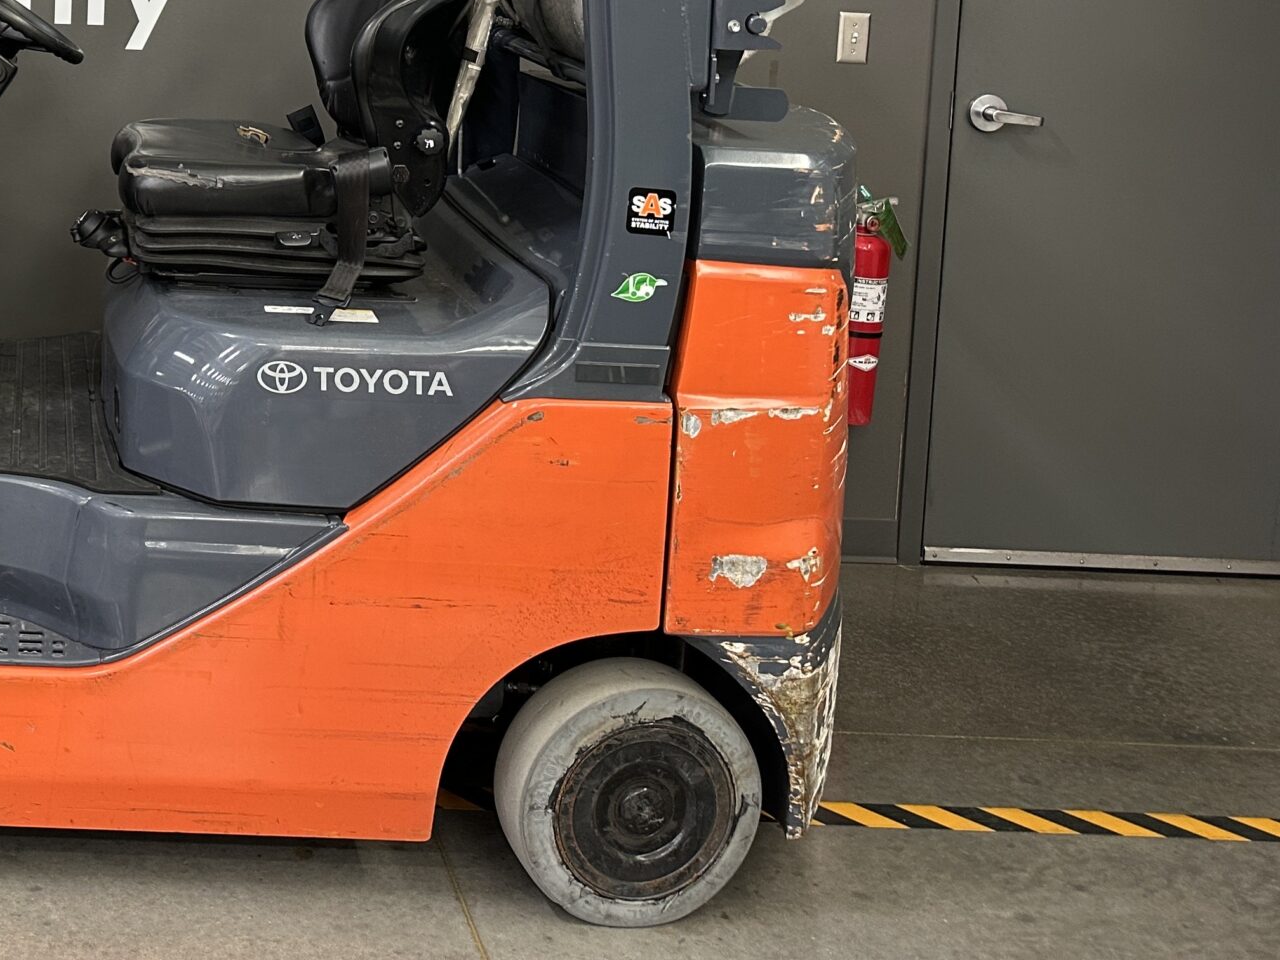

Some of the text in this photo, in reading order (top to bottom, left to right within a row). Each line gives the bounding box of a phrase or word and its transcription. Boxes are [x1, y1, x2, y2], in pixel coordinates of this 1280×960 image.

[631, 193, 672, 218] SAS
[631, 222, 669, 230] STABILITY
[313, 366, 454, 397] TOYOTA
